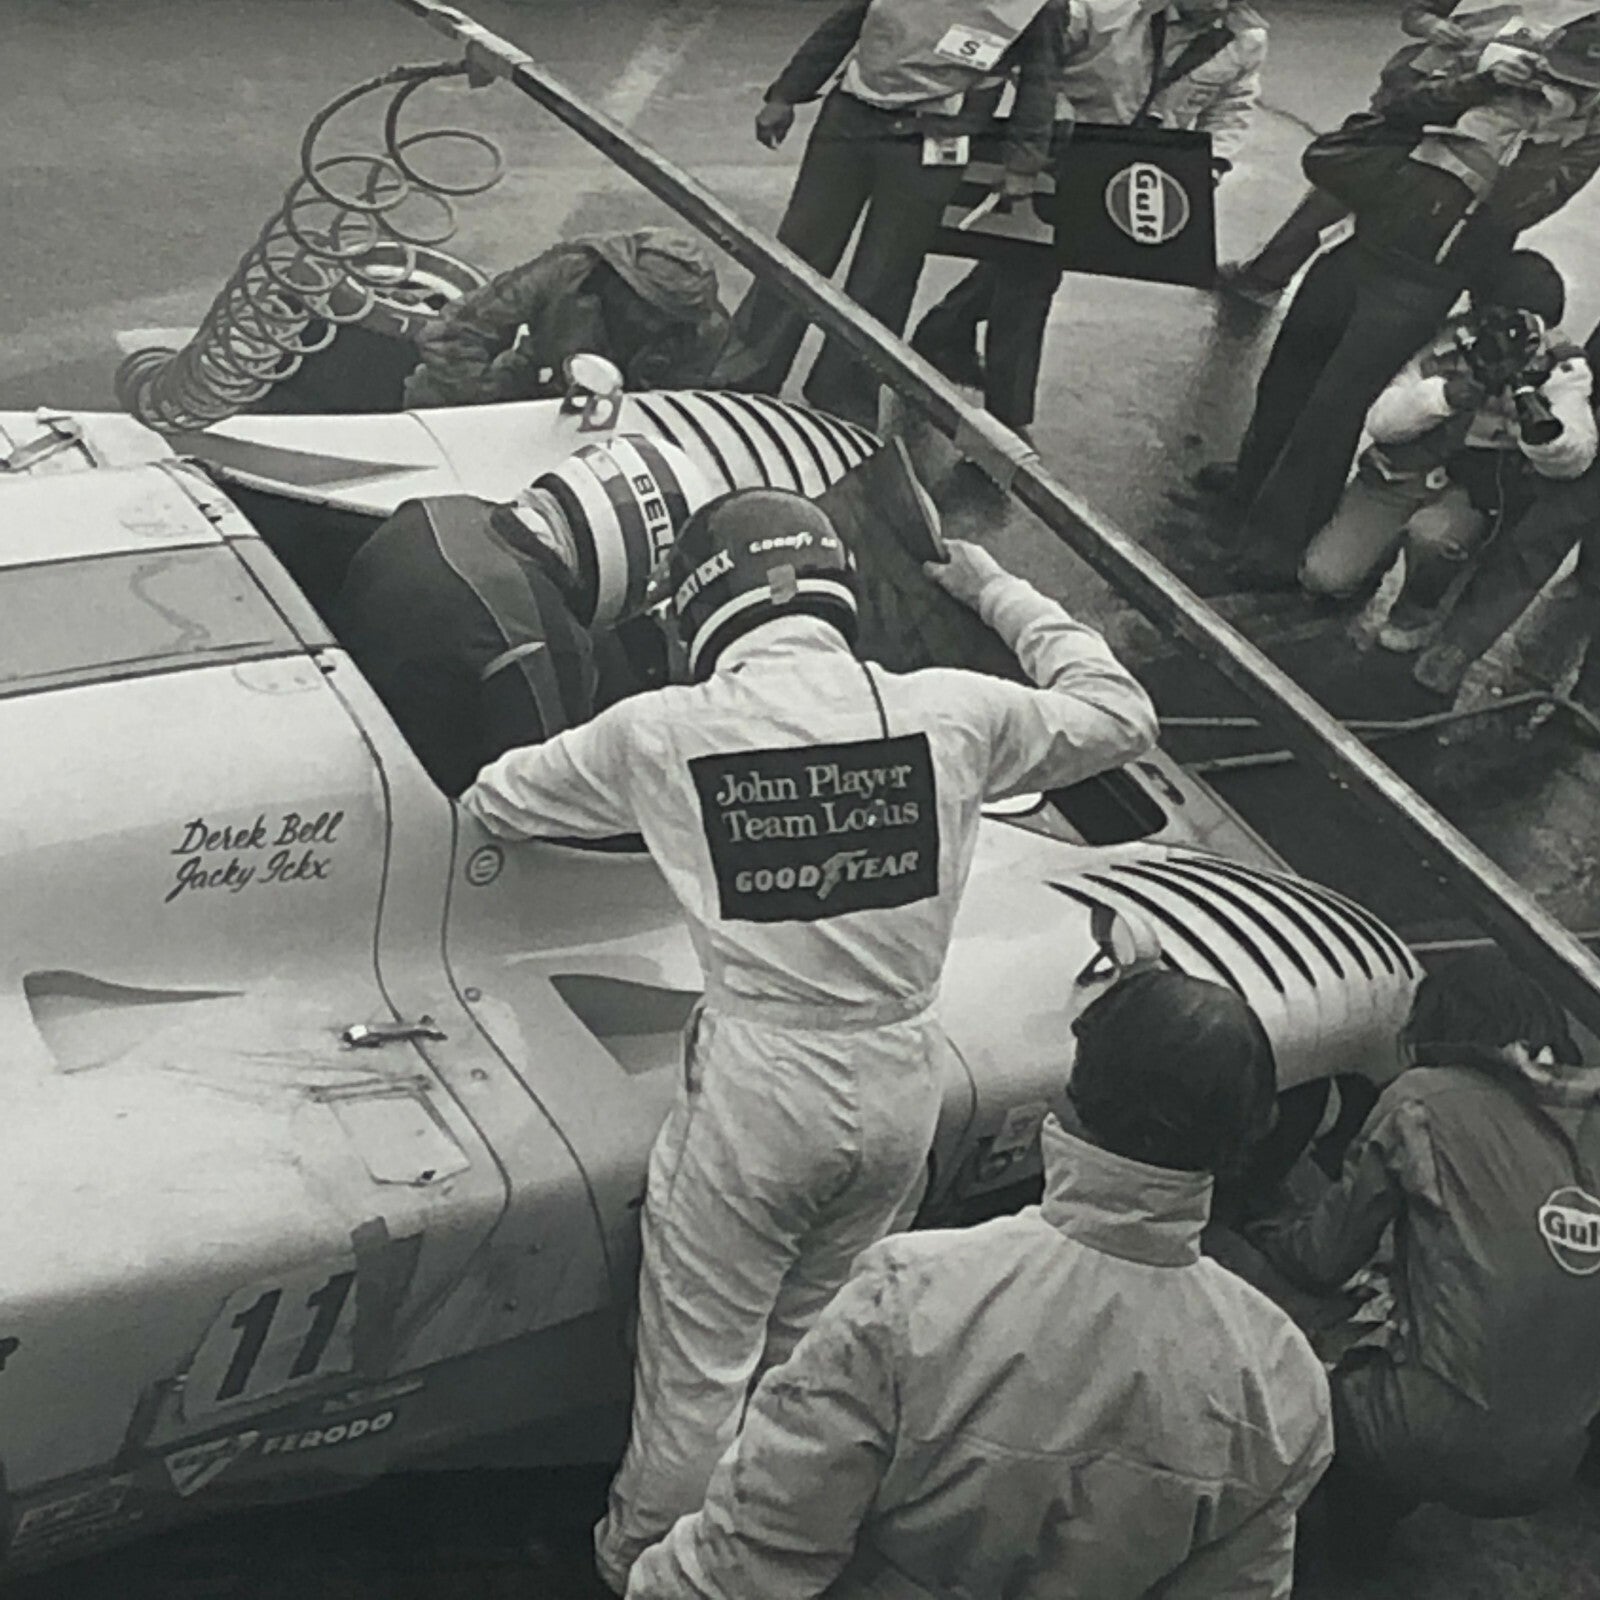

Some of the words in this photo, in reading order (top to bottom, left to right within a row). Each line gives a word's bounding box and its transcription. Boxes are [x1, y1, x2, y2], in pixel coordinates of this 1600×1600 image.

[1136, 170, 1158, 238] Gulf
[631, 473, 675, 565] BELL
[716, 771, 799, 806] John
[171, 816, 268, 855] Derek
[273, 810, 345, 848] Bell
[721, 810, 818, 843] Team
[165, 856, 257, 903] Jacky
[257, 849, 332, 884] Ickx
[735, 849, 920, 900] GOODYEAR
[1543, 1210, 1600, 1247] Gul
[215, 1269, 357, 1402] 11
[262, 1411, 395, 1455] FERODO
